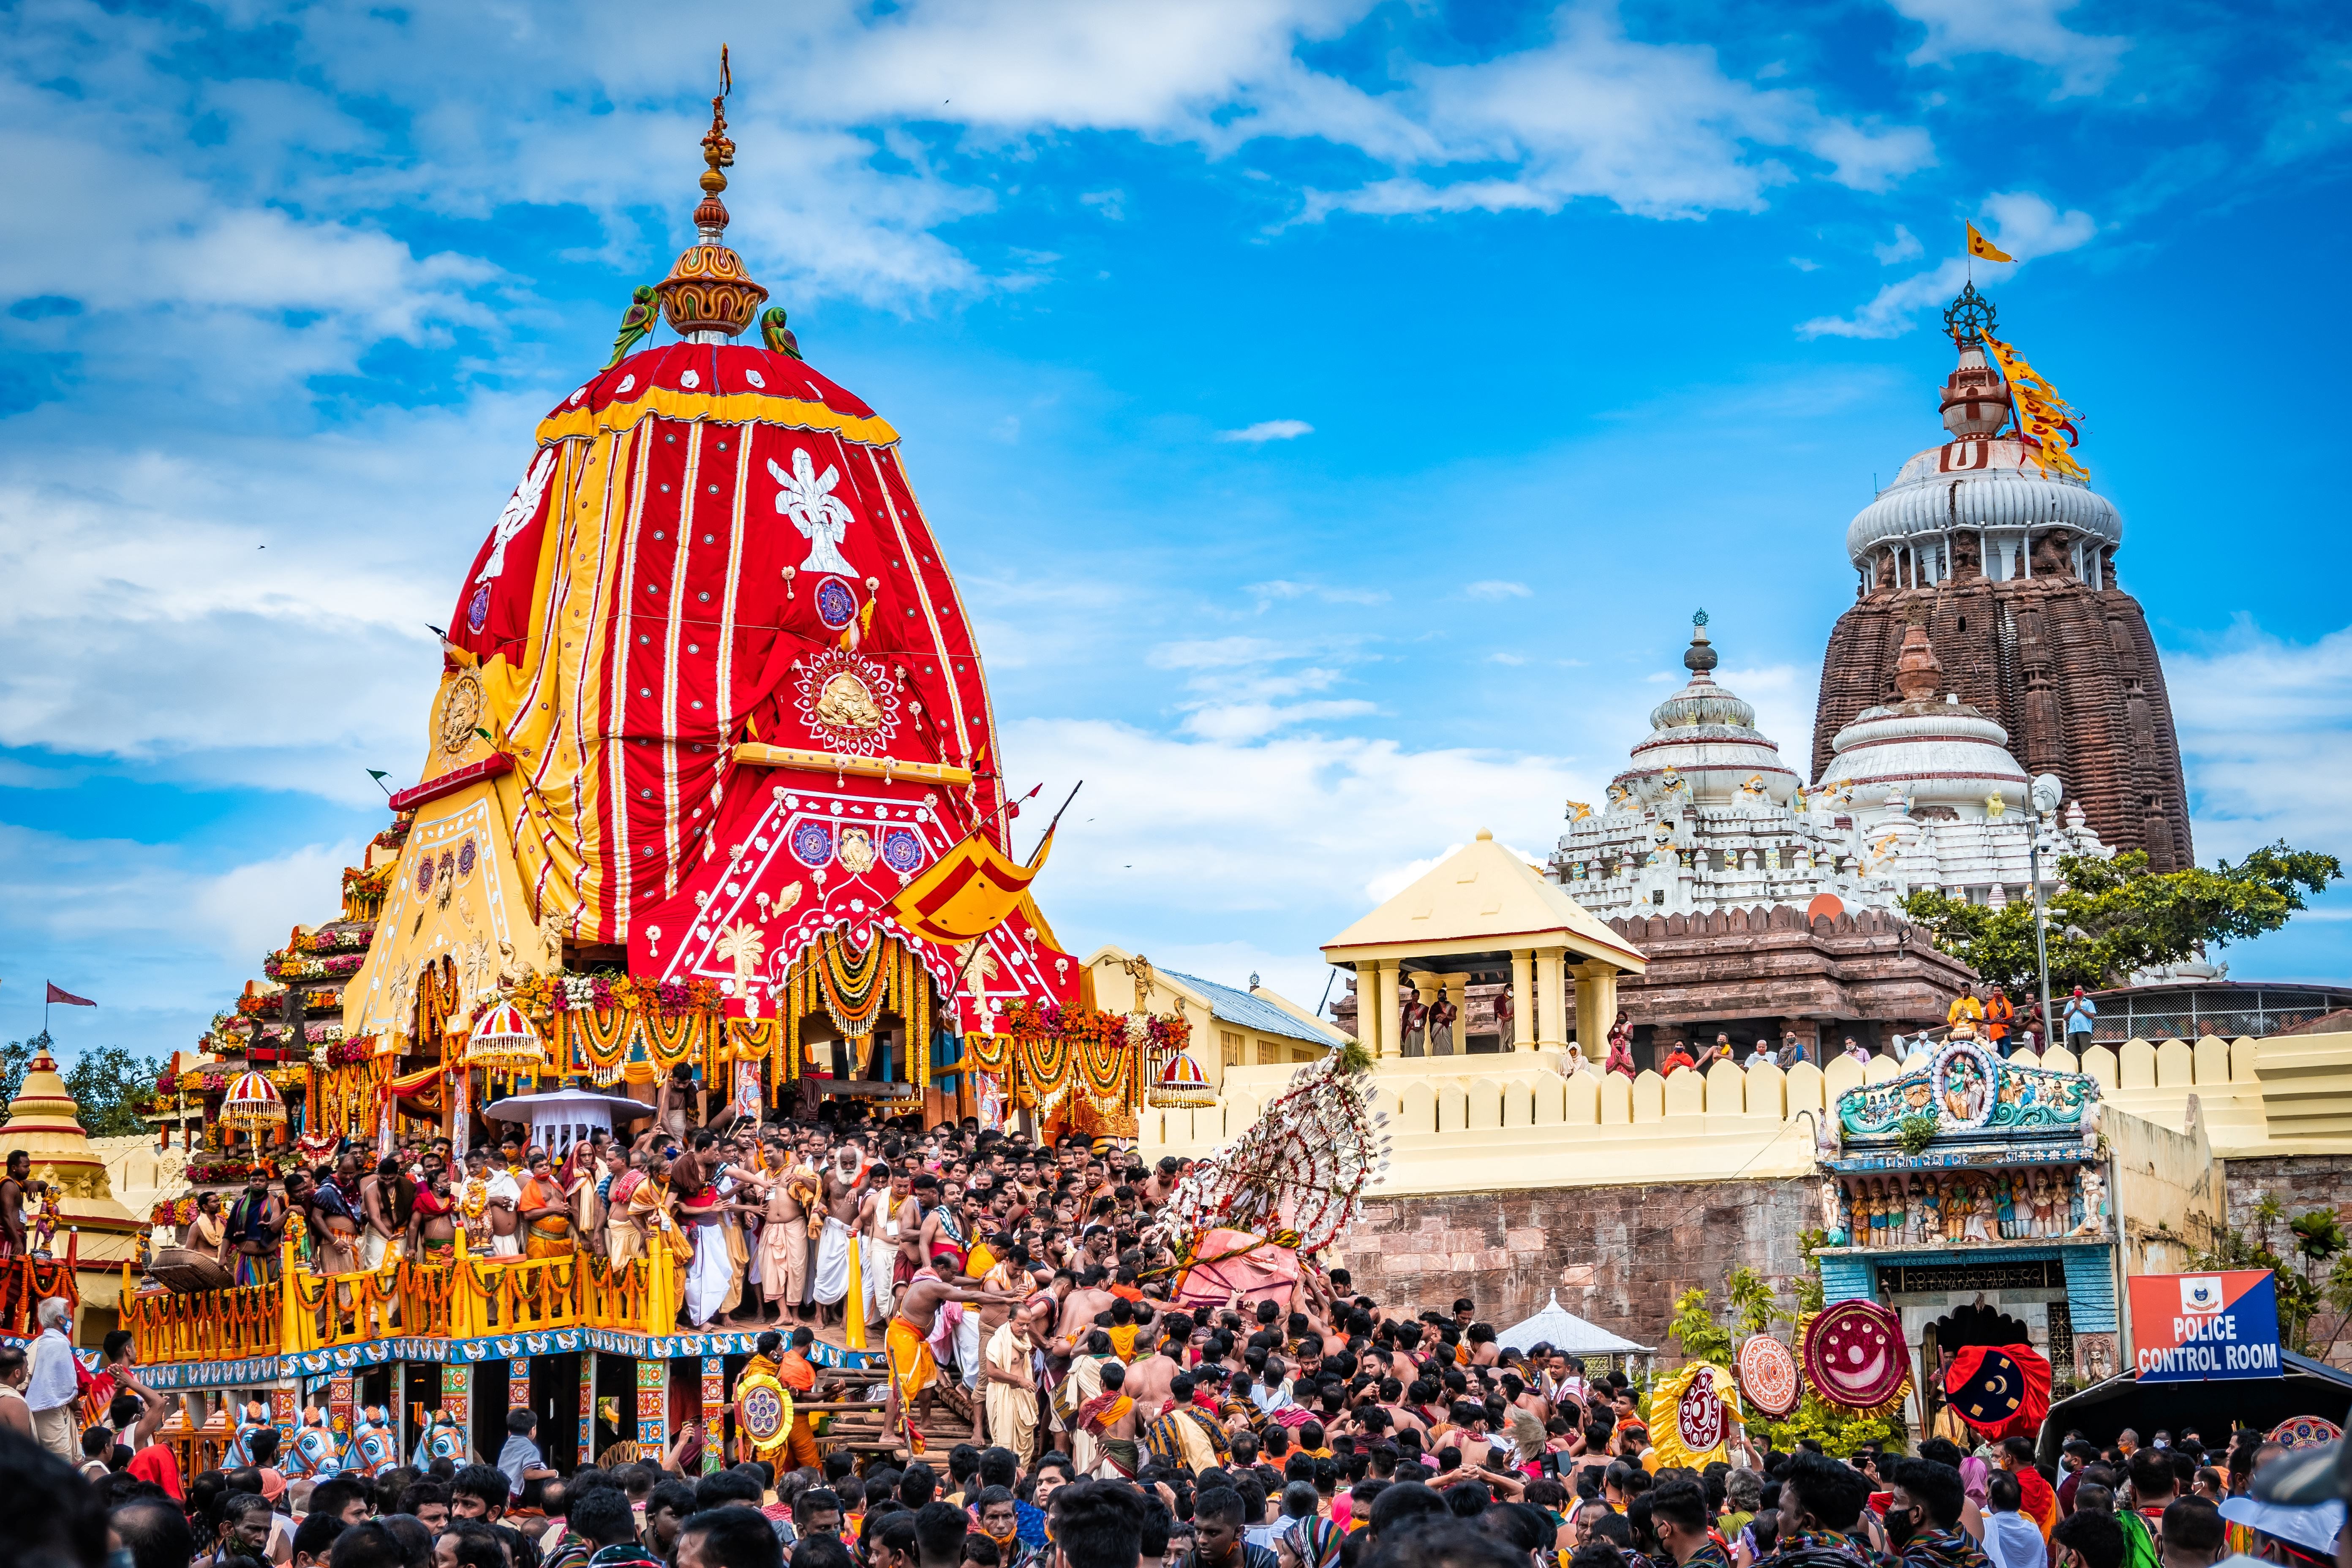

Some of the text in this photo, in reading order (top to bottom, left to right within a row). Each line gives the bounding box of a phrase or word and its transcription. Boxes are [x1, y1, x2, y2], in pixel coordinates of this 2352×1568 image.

[1906, 1278, 2042, 1291] SHRI RAMADAYA PARISADA
[2173, 1315, 2237, 1342] POLICE
[2138, 1343, 2278, 1373] CONTROL ROOM
